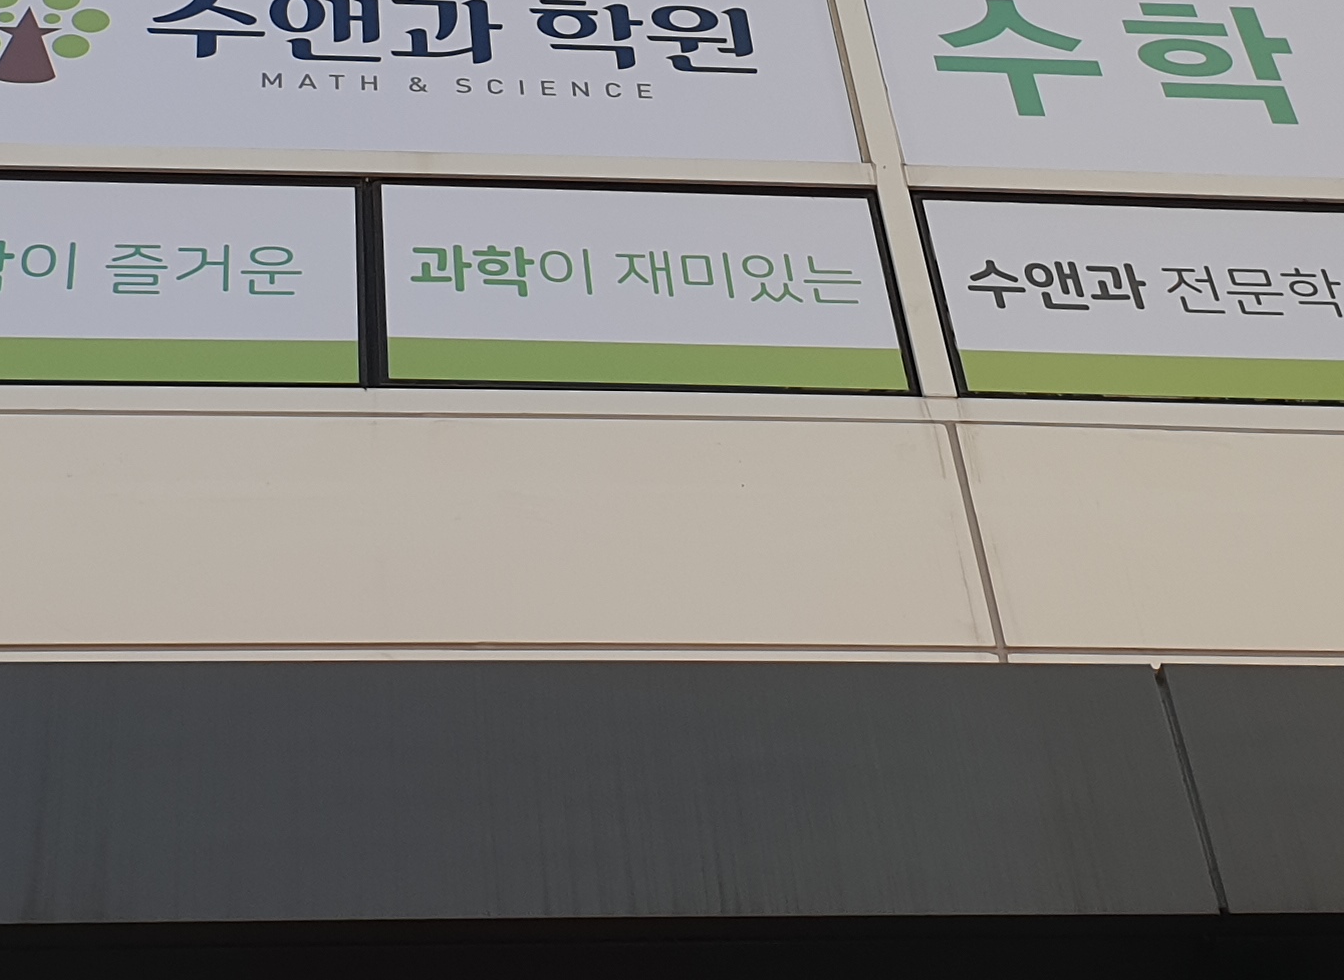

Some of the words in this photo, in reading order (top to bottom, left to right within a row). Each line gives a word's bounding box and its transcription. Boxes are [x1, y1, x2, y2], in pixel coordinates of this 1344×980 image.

[261, 72, 378, 92] MATH
[408, 76, 427, 93] &
[455, 77, 653, 100] SCIENCE
[105, 243, 303, 296] 즐거운
[410, 244, 593, 298] 과학이
[615, 250, 862, 305] 재미있는
[967, 259, 1147, 311] 수앤과
